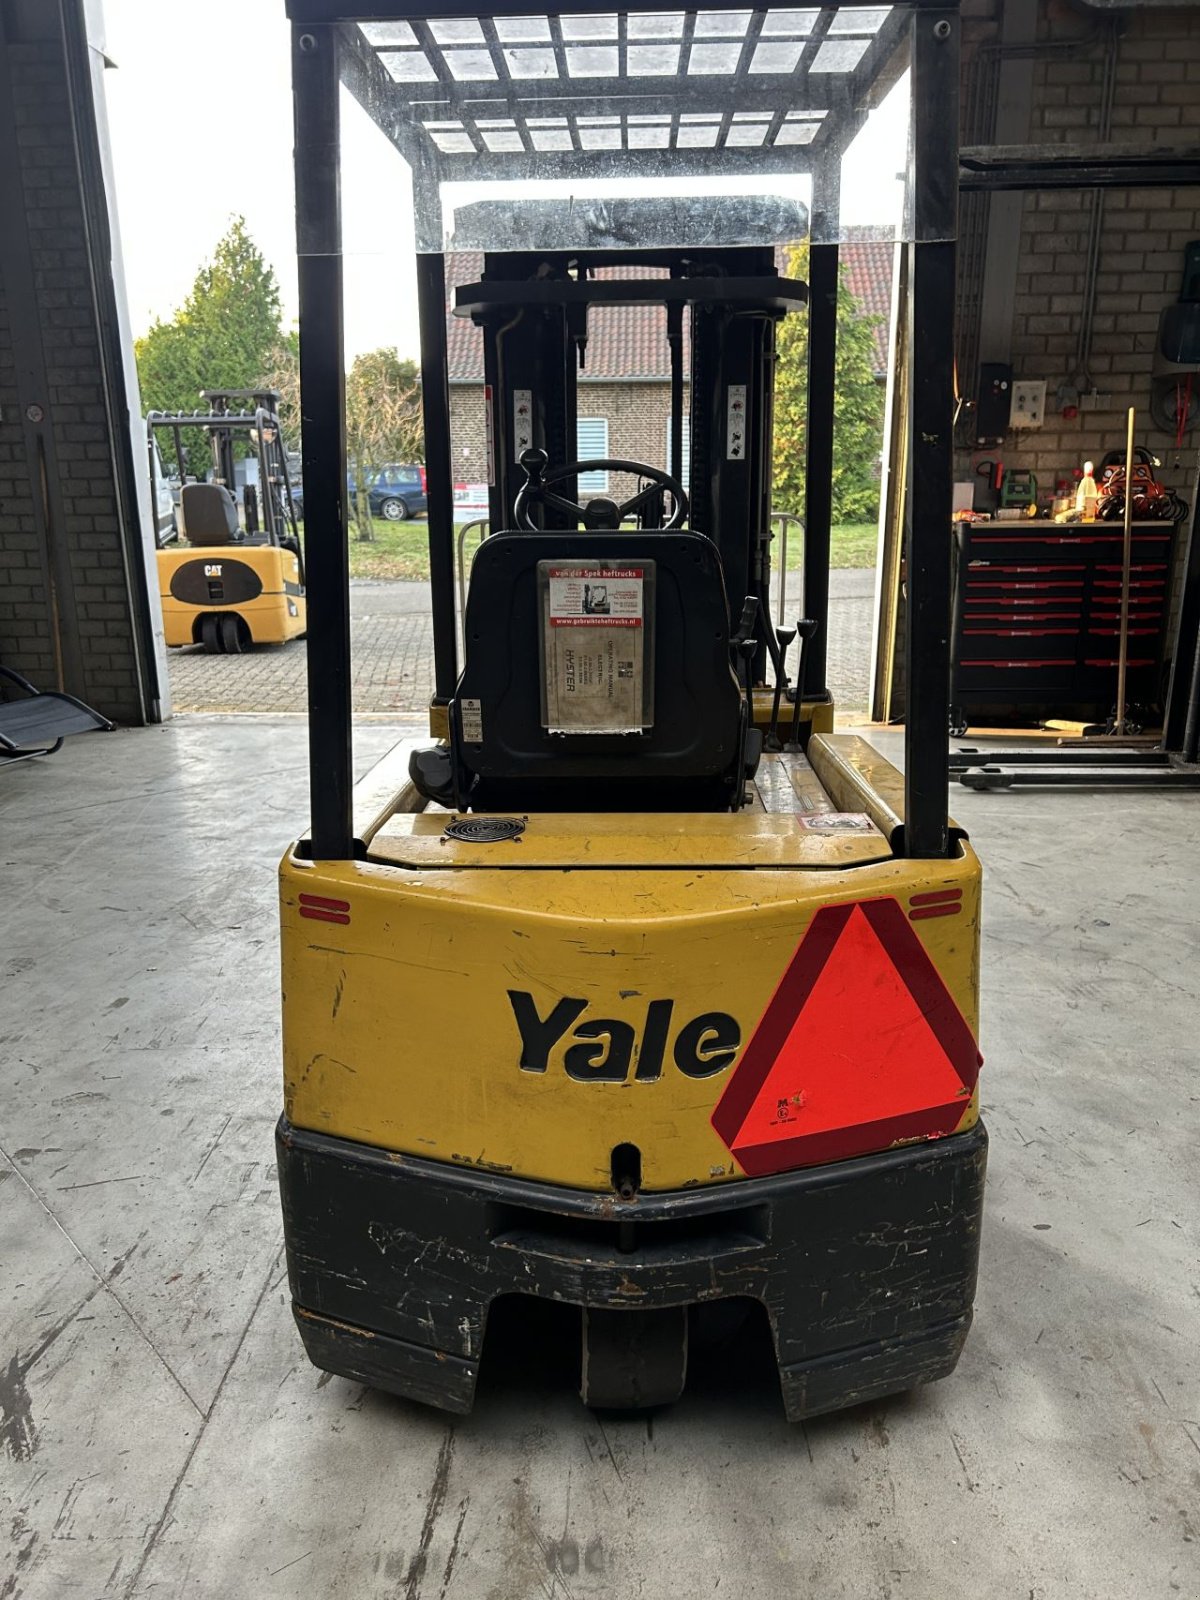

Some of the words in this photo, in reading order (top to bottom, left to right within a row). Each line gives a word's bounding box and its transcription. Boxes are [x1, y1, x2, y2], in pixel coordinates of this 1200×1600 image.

[204, 565, 223, 577] CAT
[584, 569, 602, 578] Spek
[603, 569, 637, 577] heftrucks
[566, 649, 575, 692] HYSTER
[506, 989, 741, 1083] Yale
